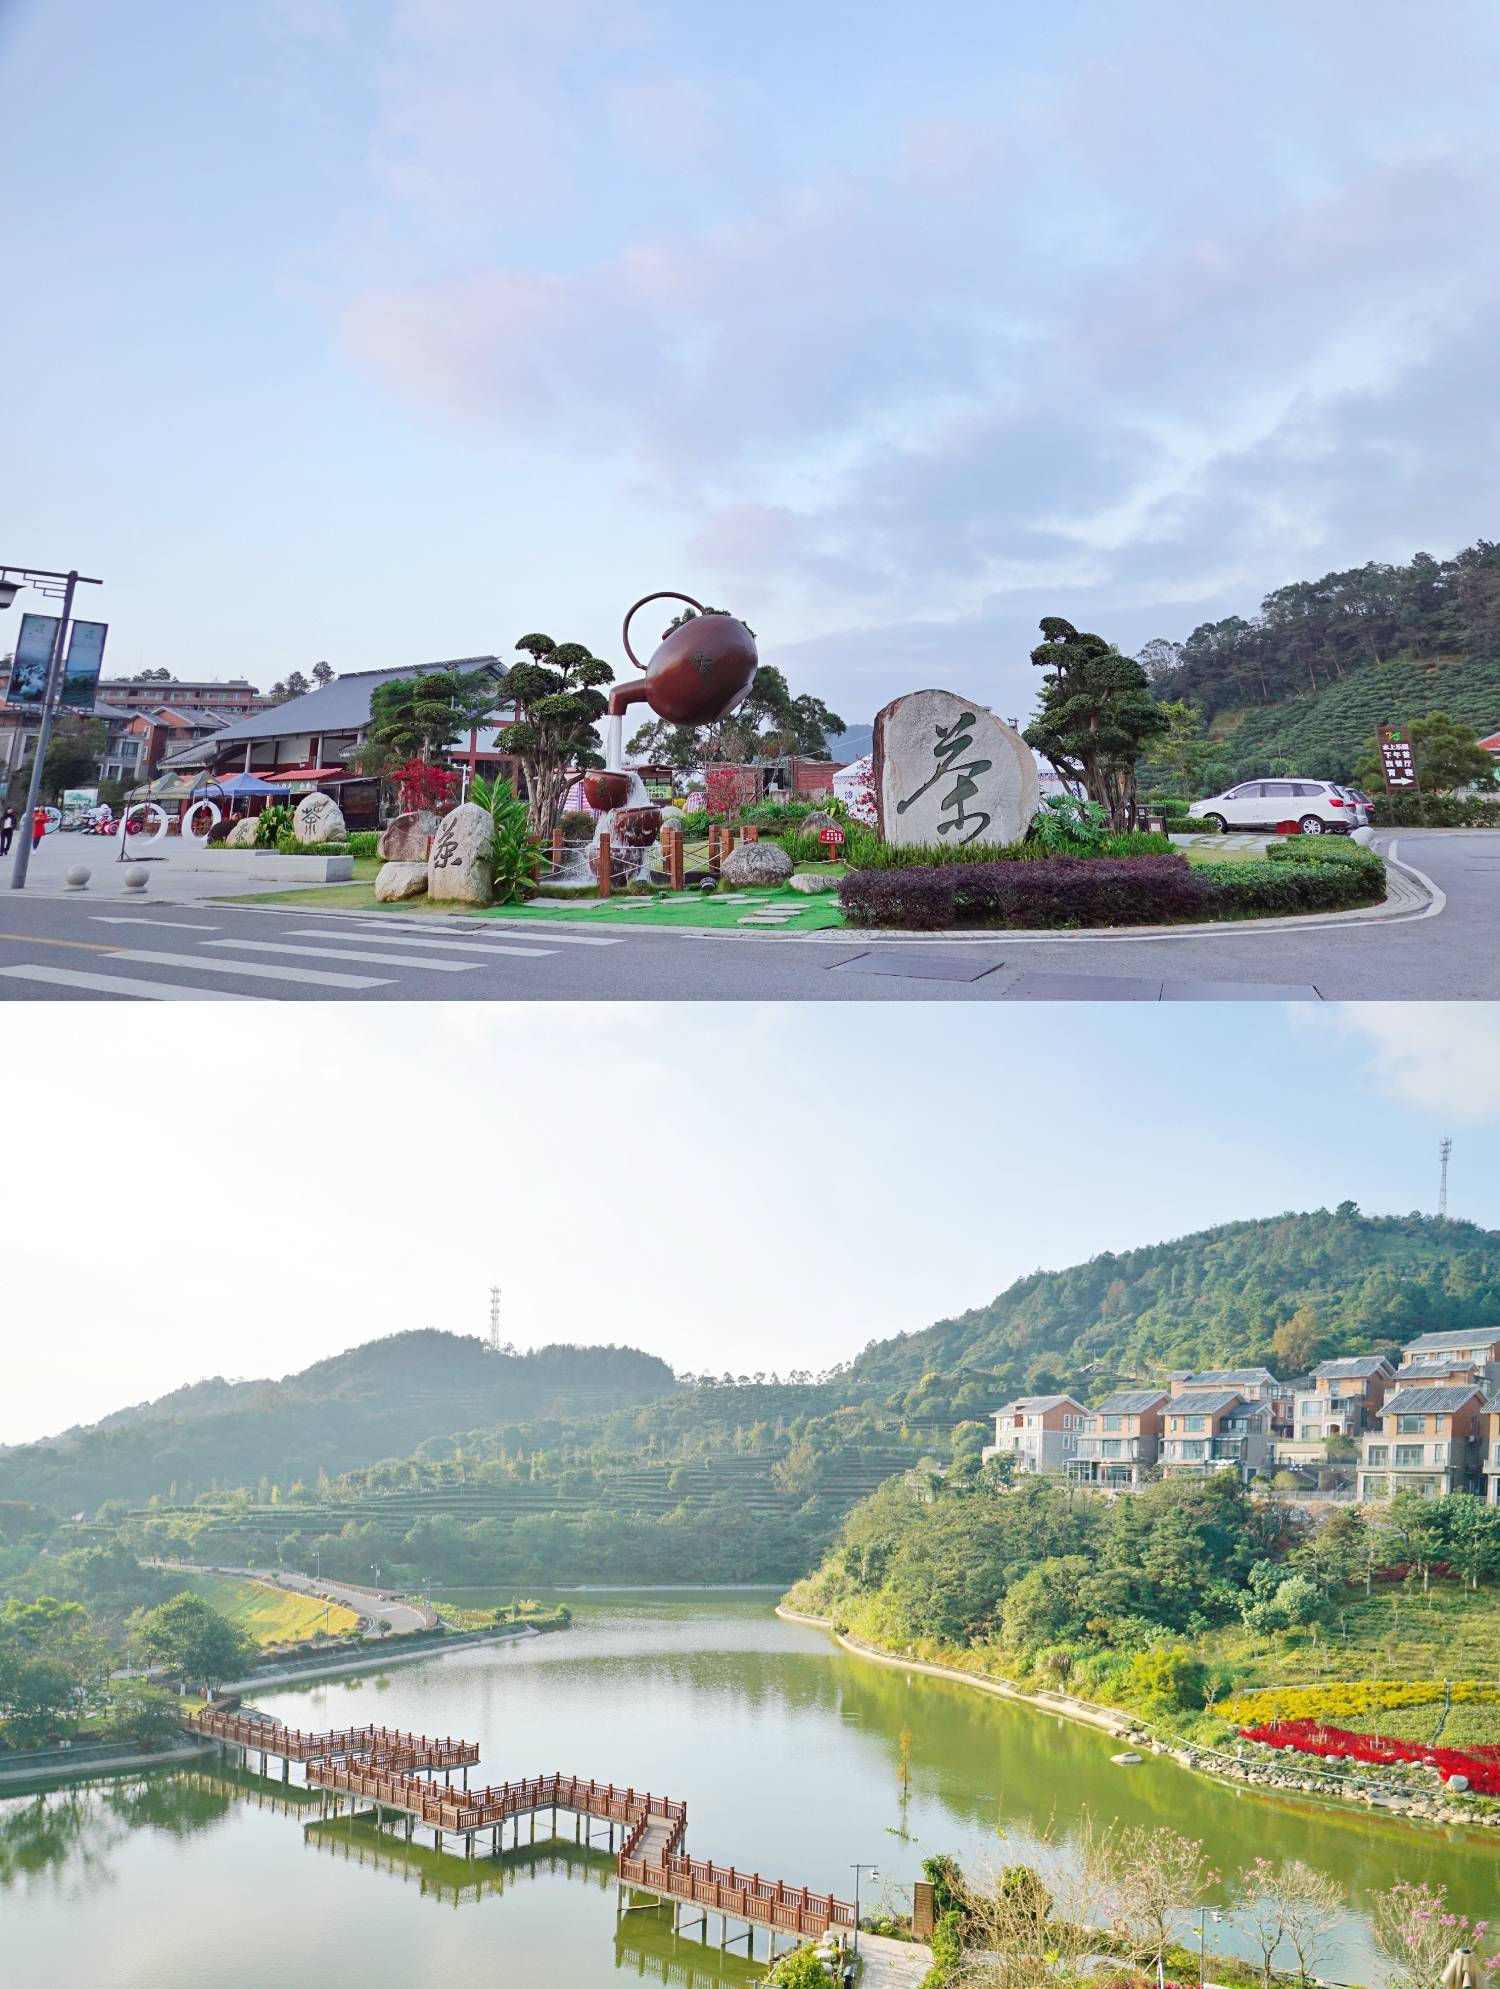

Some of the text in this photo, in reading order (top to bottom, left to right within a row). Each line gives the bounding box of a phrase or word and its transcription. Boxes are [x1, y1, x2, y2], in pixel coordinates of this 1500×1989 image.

[897, 711, 993, 845] 茶
[1384, 751, 1411, 759] 下午茶
